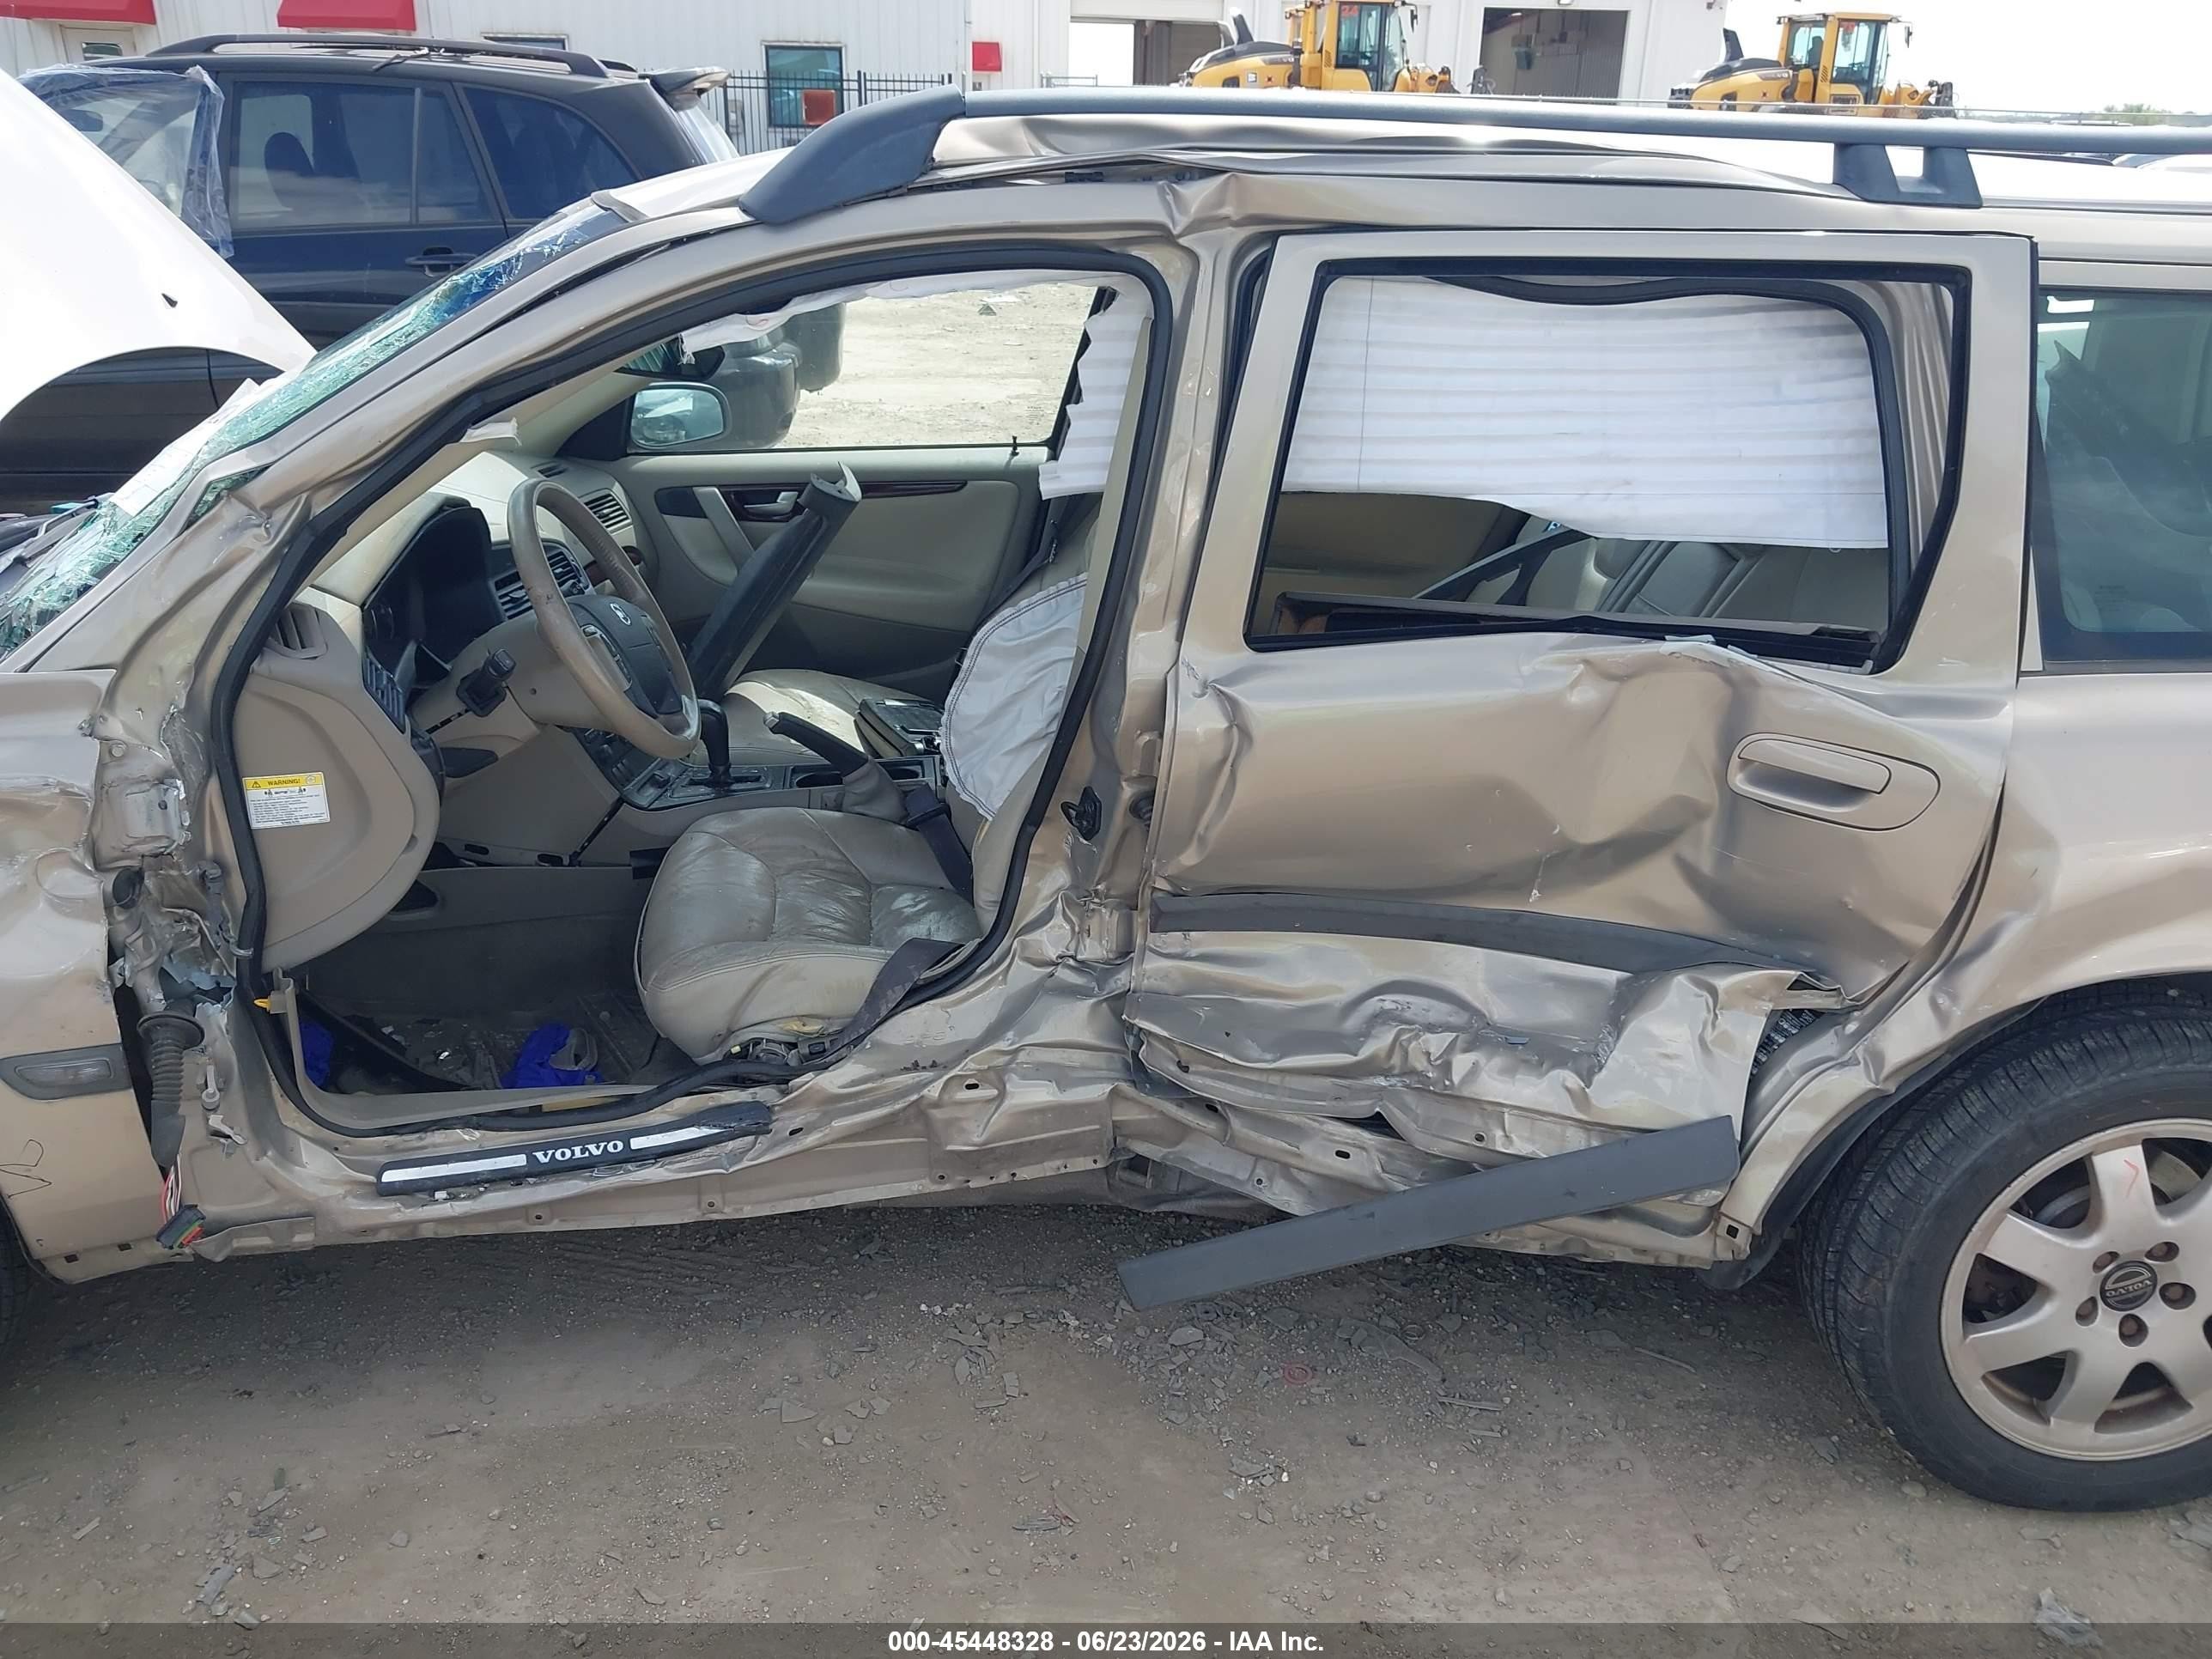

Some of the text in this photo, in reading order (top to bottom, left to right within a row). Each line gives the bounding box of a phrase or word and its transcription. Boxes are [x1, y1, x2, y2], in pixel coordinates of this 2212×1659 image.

[267, 778, 301, 787] WARNING!
[532, 1140, 623, 1164] VOLVO
[2106, 1279, 2152, 1297] VOLVO
